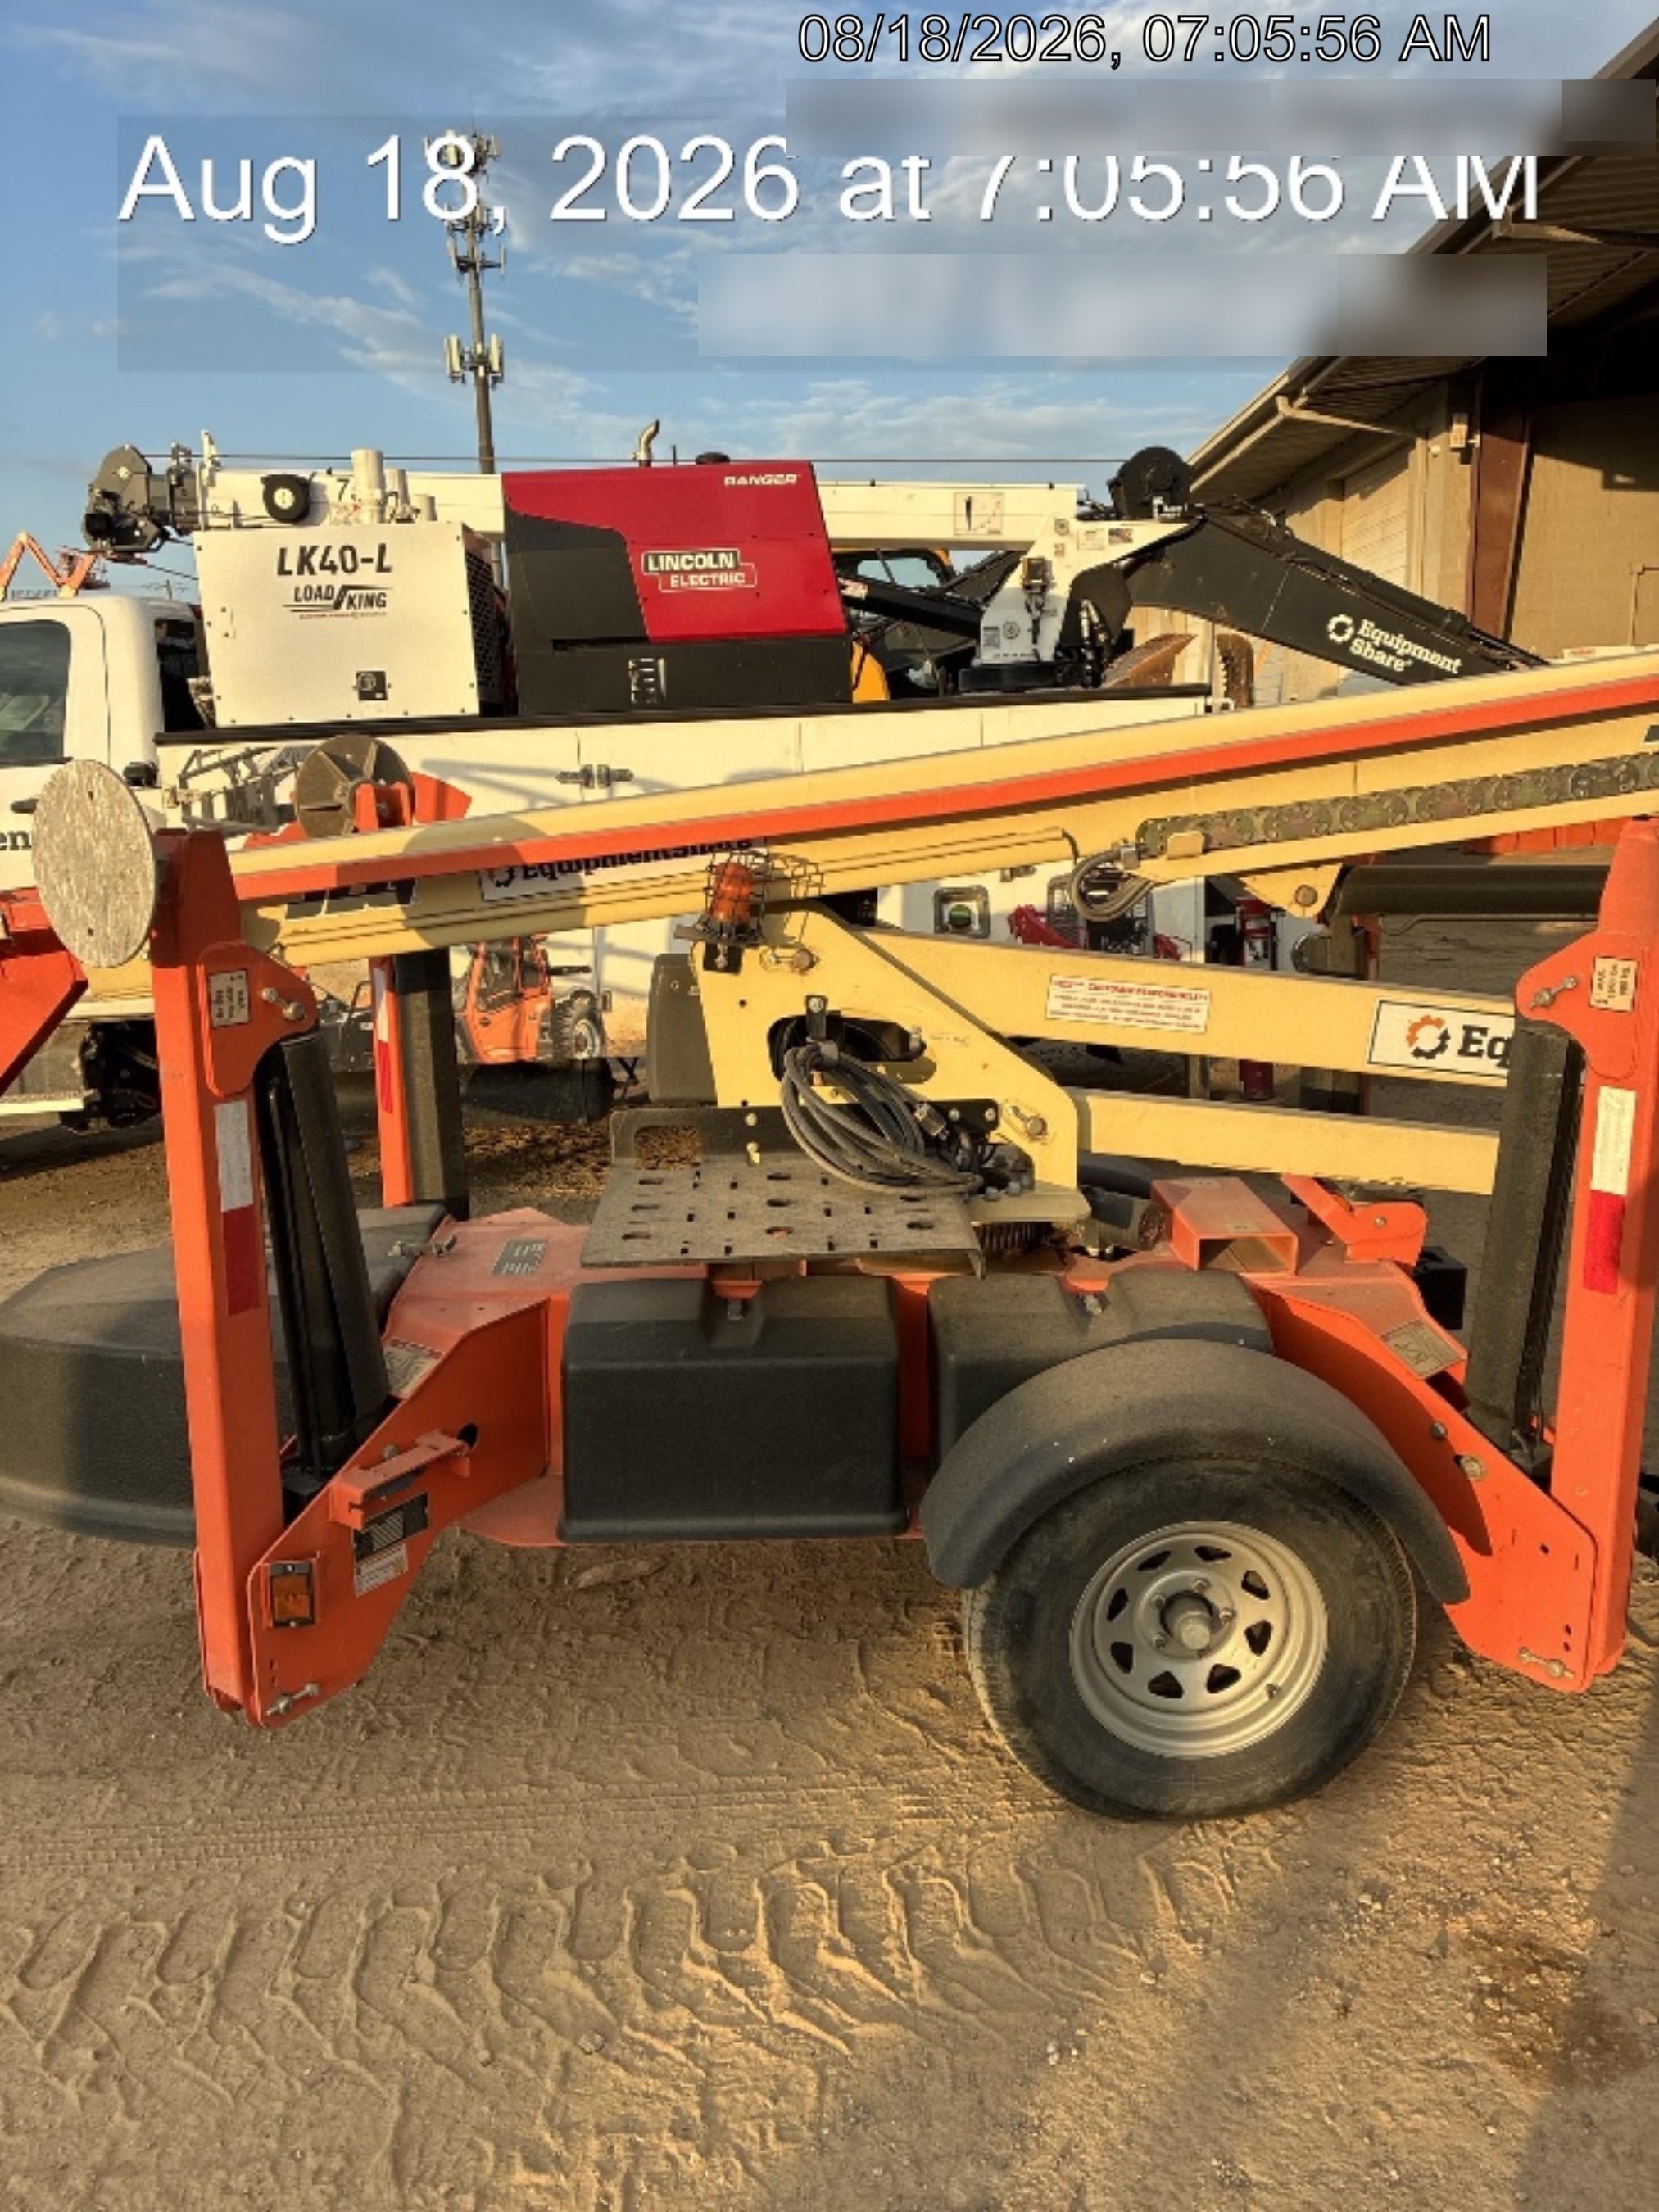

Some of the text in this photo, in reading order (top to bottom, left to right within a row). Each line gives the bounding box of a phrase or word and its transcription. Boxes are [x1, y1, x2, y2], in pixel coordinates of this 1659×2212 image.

[724, 474, 797, 486] RANGER
[277, 543, 393, 576] LK40-L
[647, 552, 734, 571] LINCOLN
[670, 572, 746, 588] ELECTRIC
[294, 584, 387, 610] LOAD KING
[1350, 637, 1405, 672] Share
[1357, 619, 1462, 674] Equipment
